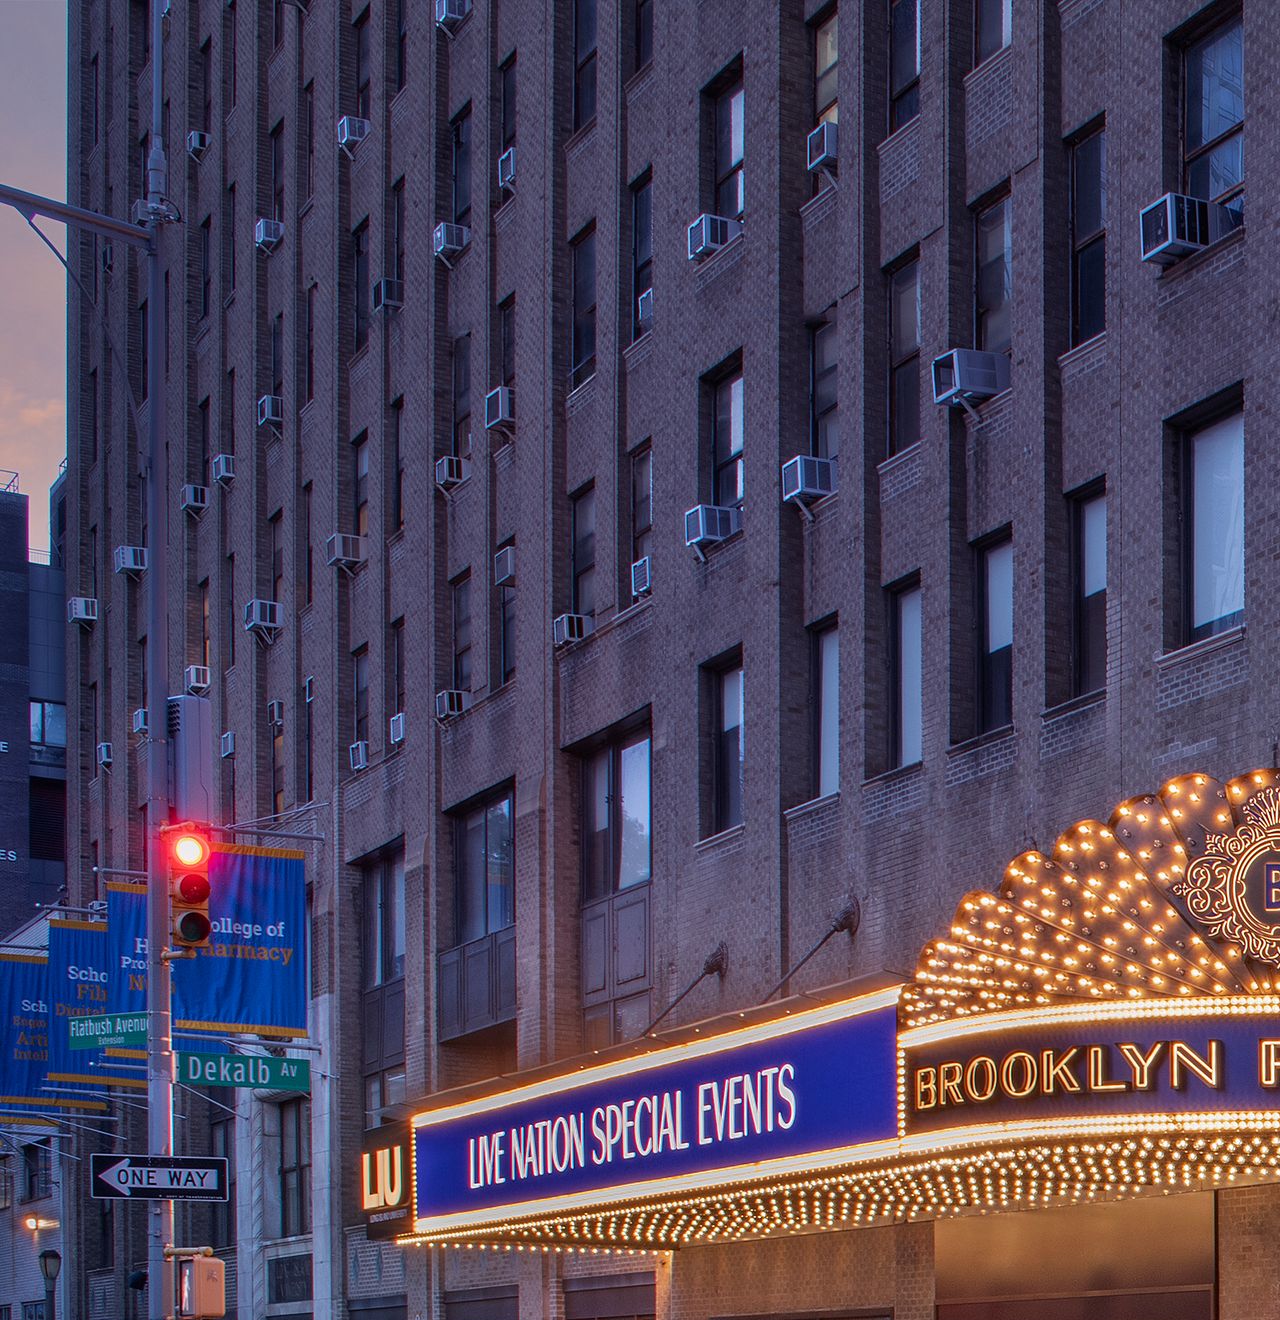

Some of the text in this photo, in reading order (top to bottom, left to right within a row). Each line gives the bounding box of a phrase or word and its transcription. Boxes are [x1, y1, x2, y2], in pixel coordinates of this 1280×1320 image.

[210, 918, 285, 939] ollege of
[200, 942, 294, 966] harmacy
[70, 1022, 112, 1037] Flatbush
[98, 1036, 125, 1045] Extension
[188, 1056, 298, 1084] Dekalb Av
[914, 1037, 1222, 1111] BROOKLYN
[468, 1063, 796, 1190] LIVE NATION SPECIAL EVENTS
[117, 1168, 209, 1187] ONE WAY
[362, 1145, 402, 1210] LIU
